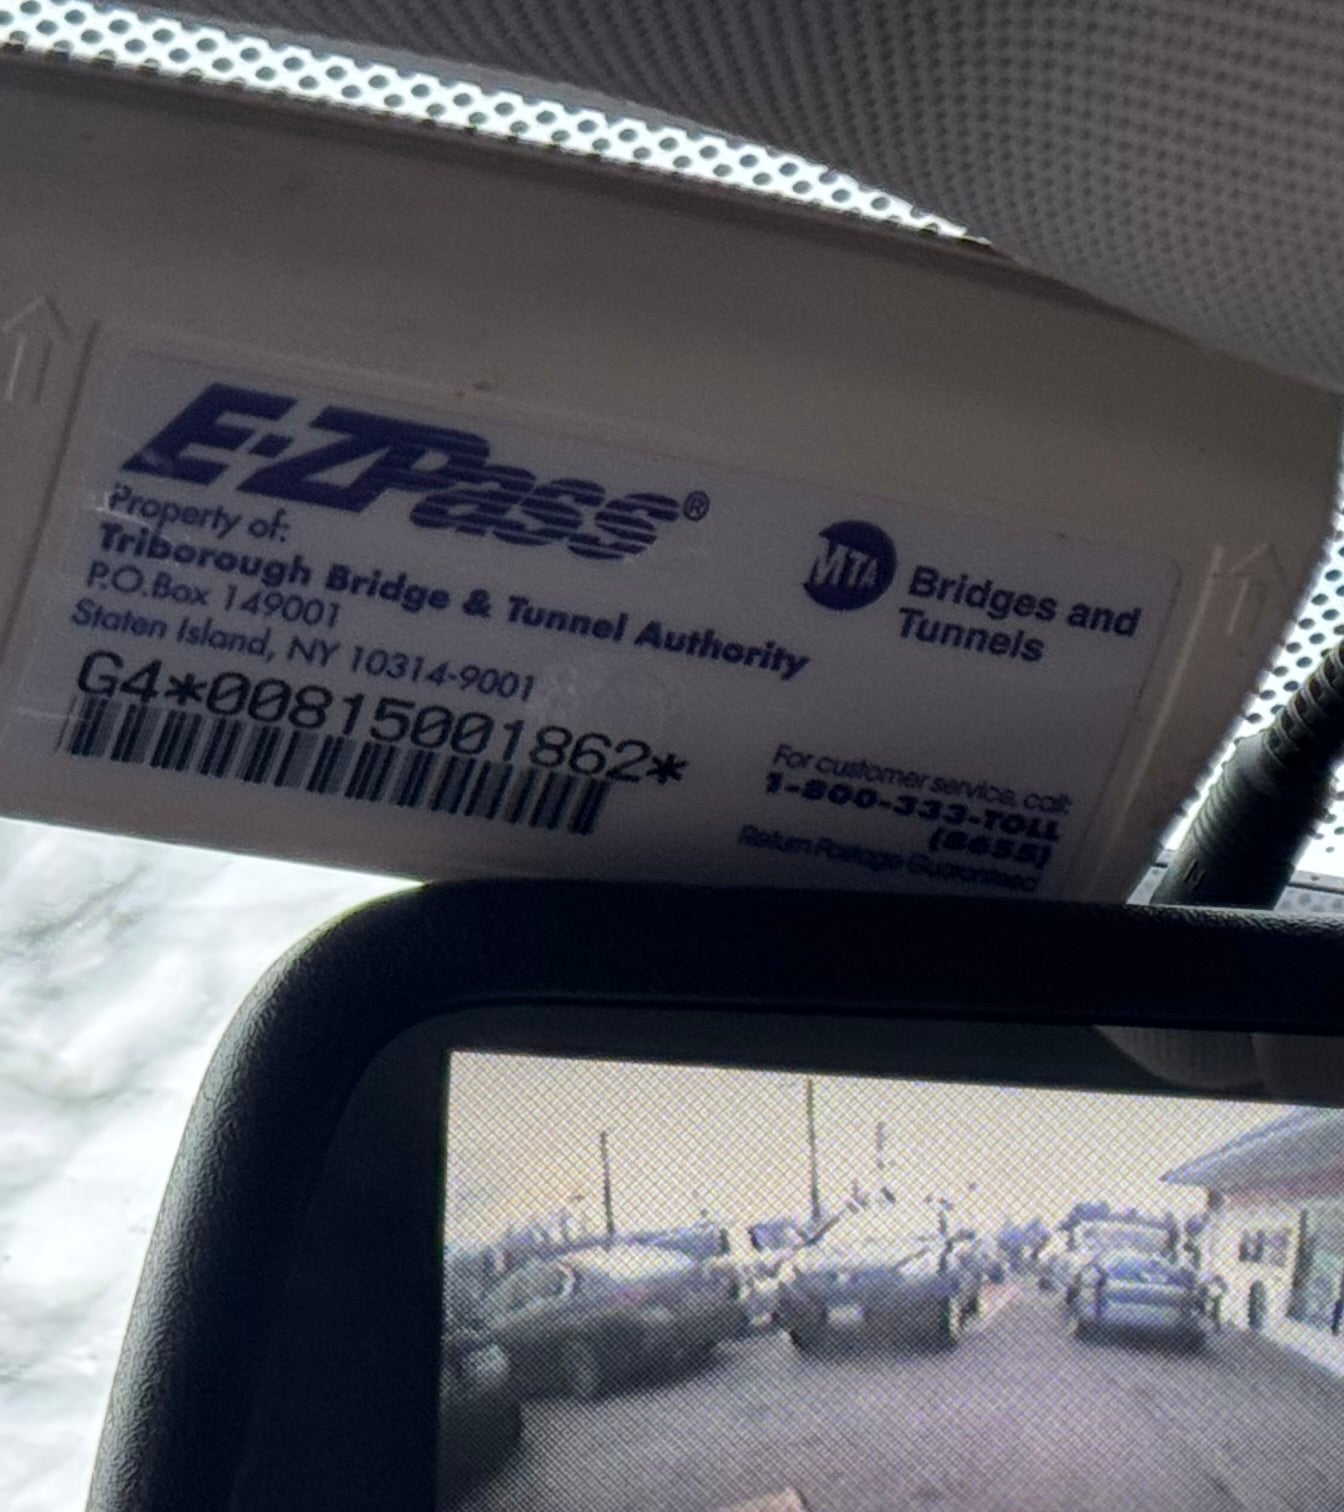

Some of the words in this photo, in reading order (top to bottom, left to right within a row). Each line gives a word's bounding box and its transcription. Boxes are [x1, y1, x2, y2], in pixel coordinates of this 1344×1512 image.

[108, 481, 243, 540] Property
[246, 507, 291, 543] of:
[100, 521, 314, 589] Triborough
[325, 561, 452, 613] Bridge
[462, 588, 493, 618] &
[507, 594, 630, 643] Tunnel
[635, 619, 811, 680] Authority
[224, 583, 341, 630] 149001
[907, 563, 1059, 624] Bridges
[1064, 601, 1145, 639] and
[71, 597, 168, 640] Staten
[176, 615, 277, 662] Island,
[287, 634, 341, 669] NY
[351, 644, 536, 703] 10314-9001
[899, 605, 1047, 662] Tunnels
[772, 743, 814, 769] For
[815, 754, 929, 789] customer
[765, 771, 1060, 841] 1-800-333-TOLL
[928, 826, 1051, 870] (8655)
